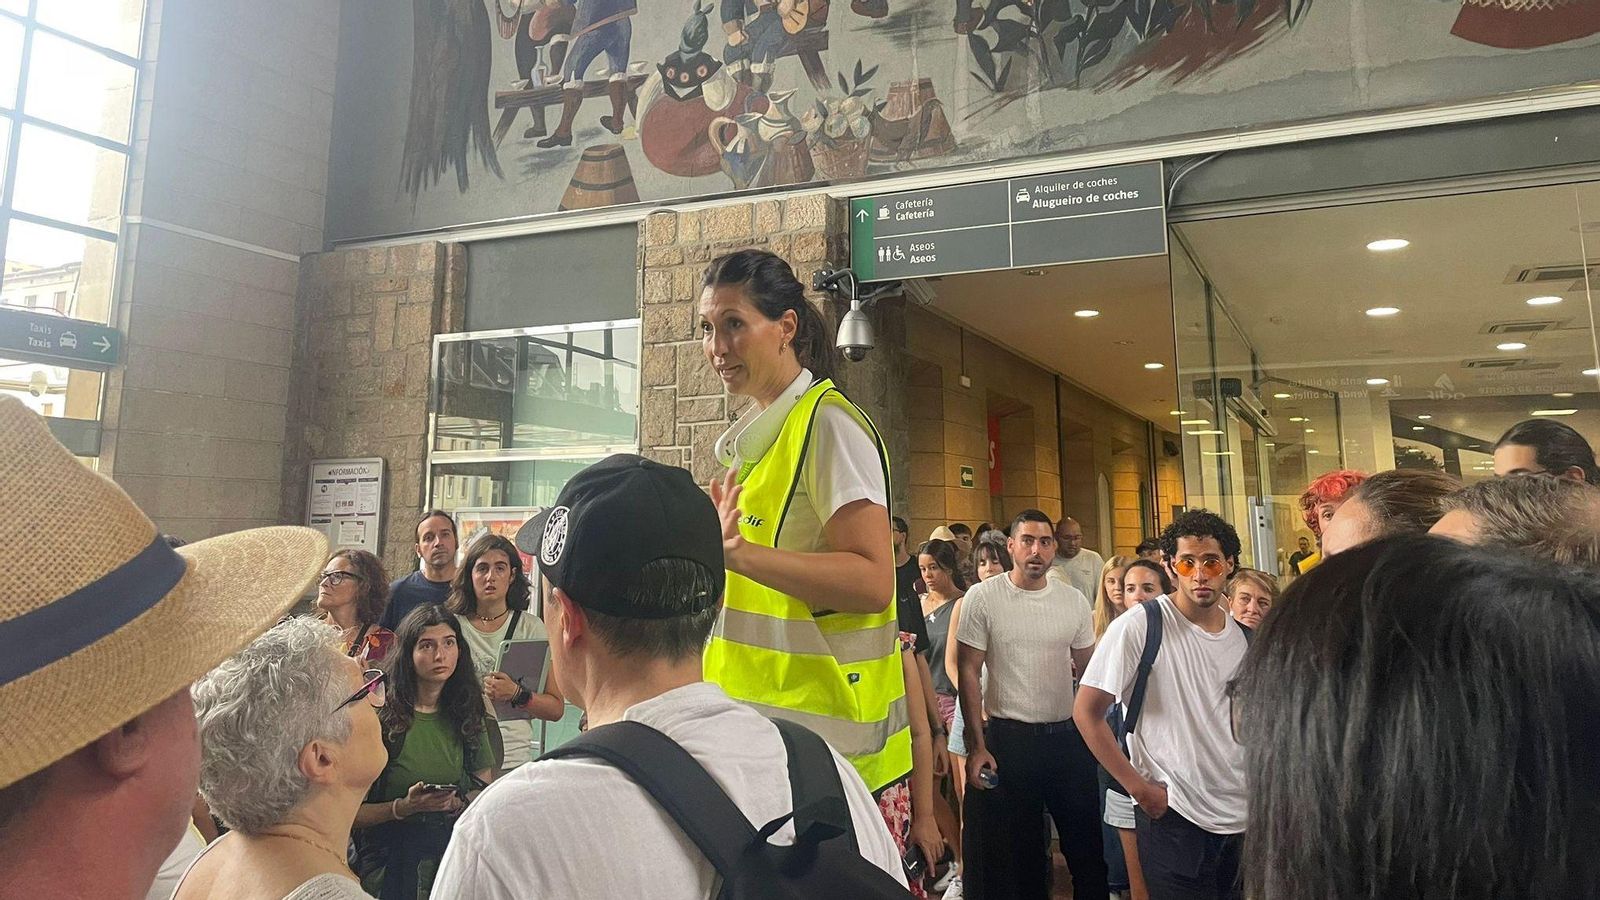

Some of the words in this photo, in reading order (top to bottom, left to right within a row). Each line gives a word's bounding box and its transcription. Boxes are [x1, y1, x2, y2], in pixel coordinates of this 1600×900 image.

[1035, 183, 1070, 194] Alquiler
[1072, 181, 1085, 190] de
[1086, 178, 1118, 188] coches
[895, 197, 934, 210] Cafetería
[1032, 195, 1083, 209] Alugueiro
[1086, 193, 1100, 203] de
[1102, 190, 1139, 202] coches
[895, 208, 935, 221] Cafetería
[910, 242, 935, 252] Aseos
[910, 254, 937, 264] Aseos
[29, 322, 52, 334] Taxis
[28, 336, 52, 348] Taxis
[741, 514, 765, 527] dif
